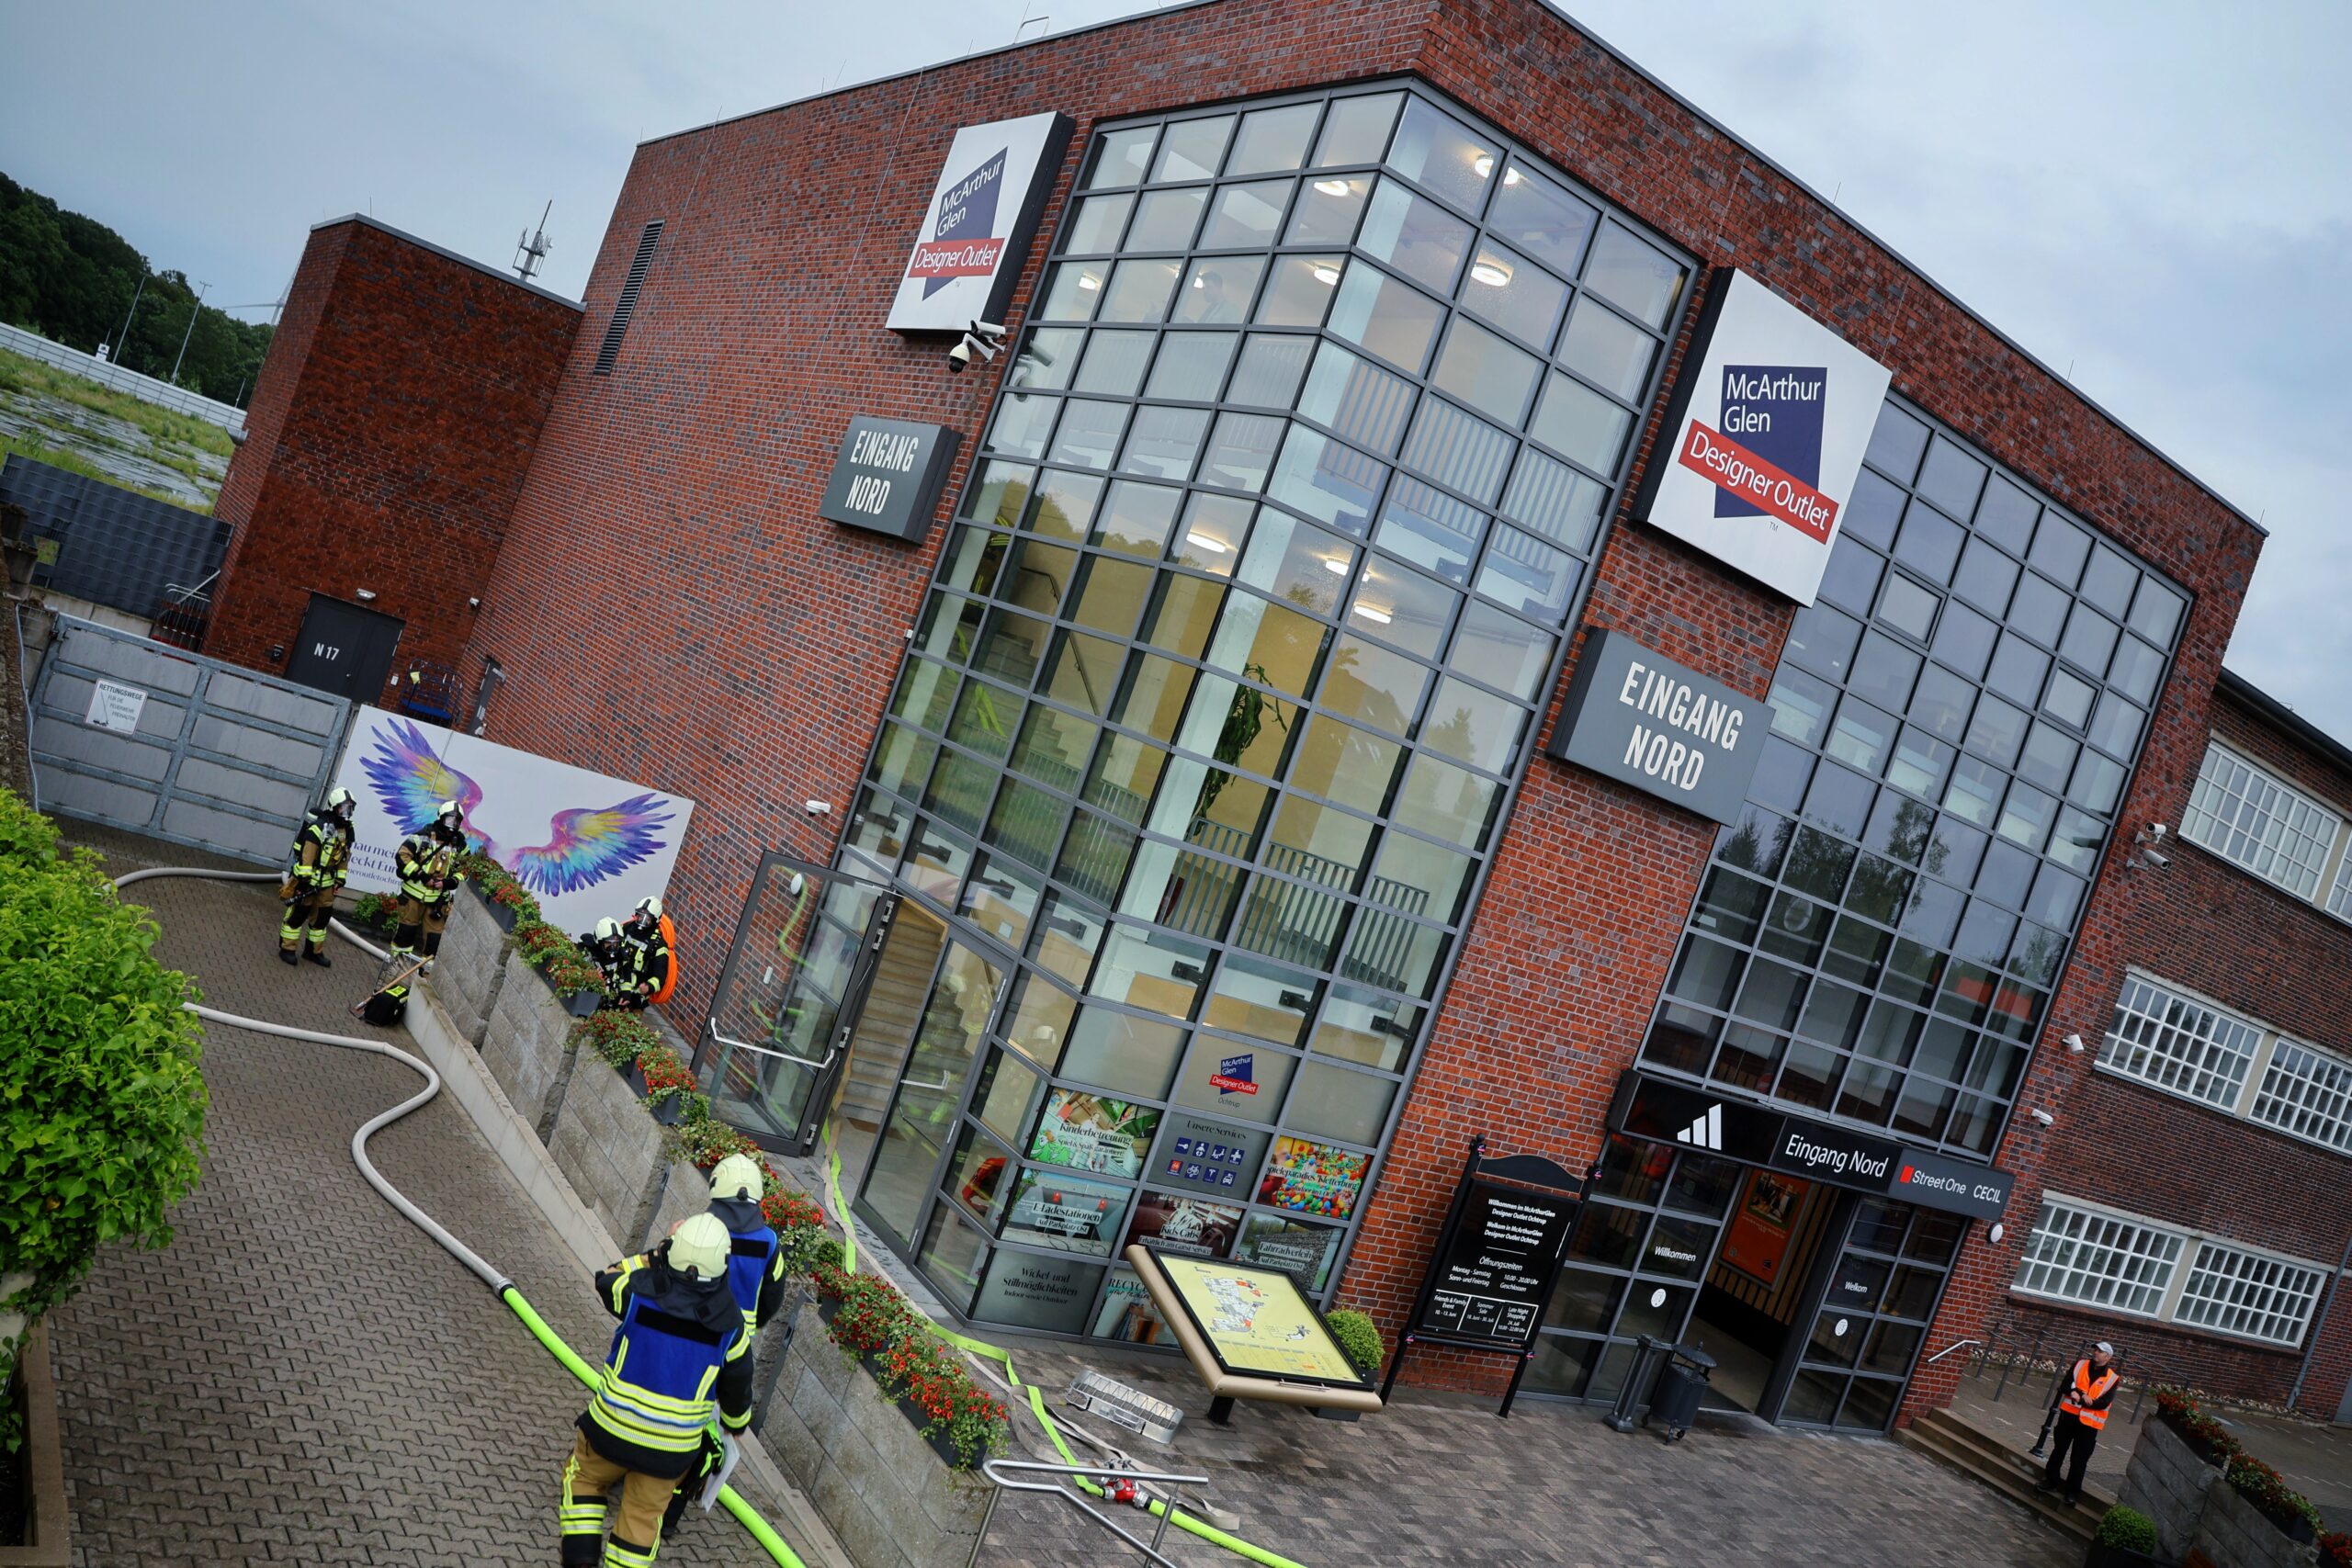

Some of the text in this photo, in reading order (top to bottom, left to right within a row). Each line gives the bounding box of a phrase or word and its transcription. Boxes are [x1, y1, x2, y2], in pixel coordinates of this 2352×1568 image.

[941, 159, 1002, 216] McArthur
[937, 207, 966, 237] Glen
[914, 243, 998, 273] Designer Outlet
[1726, 373, 1821, 400] McArthur
[1724, 405, 1770, 433] Glen
[850, 430, 919, 472] EINGANG
[1690, 430, 1830, 531] Designer Outlet
[845, 474, 891, 515] NORD
[1770, 521, 1779, 532] TM
[313, 642, 340, 660] N 17
[98, 682, 143, 701] RETTUNGSWEGE
[1619, 661, 1744, 751] EINGANG
[1623, 724, 1705, 791] NORD
[372, 846, 397, 859] mei
[1222, 1056, 1252, 1068] McArthur
[1221, 1067, 1237, 1076] Glen
[1212, 1076, 1256, 1092] Designer Outlet
[1217, 1097, 1240, 1108] Ochtrup
[1059, 1122, 1132, 1145] Kinderbetreuung
[1187, 1120, 1247, 1140] Unsere Services
[1785, 1134, 1889, 1179] Eingang Nord
[1912, 1169, 2001, 1203] Street One CECIL
[1033, 1202, 1101, 1223] E-Ladestationen
[1488, 1198, 1518, 1211] Willkommen
[1524, 1204, 1556, 1218] McArthurGlen
[1491, 1208, 1547, 1225] Designer Outlet Ochtrup
[1048, 1220, 1076, 1231] Parkplatz
[1160, 1224, 1200, 1239] Kids Cabs
[1487, 1221, 1506, 1231] Welkom
[1511, 1225, 1544, 1237] McArthurGlen
[1484, 1229, 1540, 1247] Designer Outlet Ochtrup
[1259, 1243, 1312, 1259] Fahrradverleih
[1655, 1246, 1697, 1262] Willkommen
[1269, 1258, 1294, 1268] Parkplatz
[1479, 1256, 1523, 1271] Öffnungszeiten
[1052, 1273, 1070, 1283] und
[1448, 1273, 1527, 1292] Sonn- und Feiertag Geschlossen
[1452, 1265, 1471, 1275] Montag
[1473, 1269, 1492, 1279] Samstag
[1531, 1278, 1539, 1286] Uhr
[1003, 1277, 1078, 1296] Stillmöglichkeiten
[1845, 1280, 1868, 1293] Welkom
[1434, 1294, 1450, 1303] Friends
[1453, 1298, 1467, 1306] Family
[1476, 1302, 1495, 1310] Sommer
